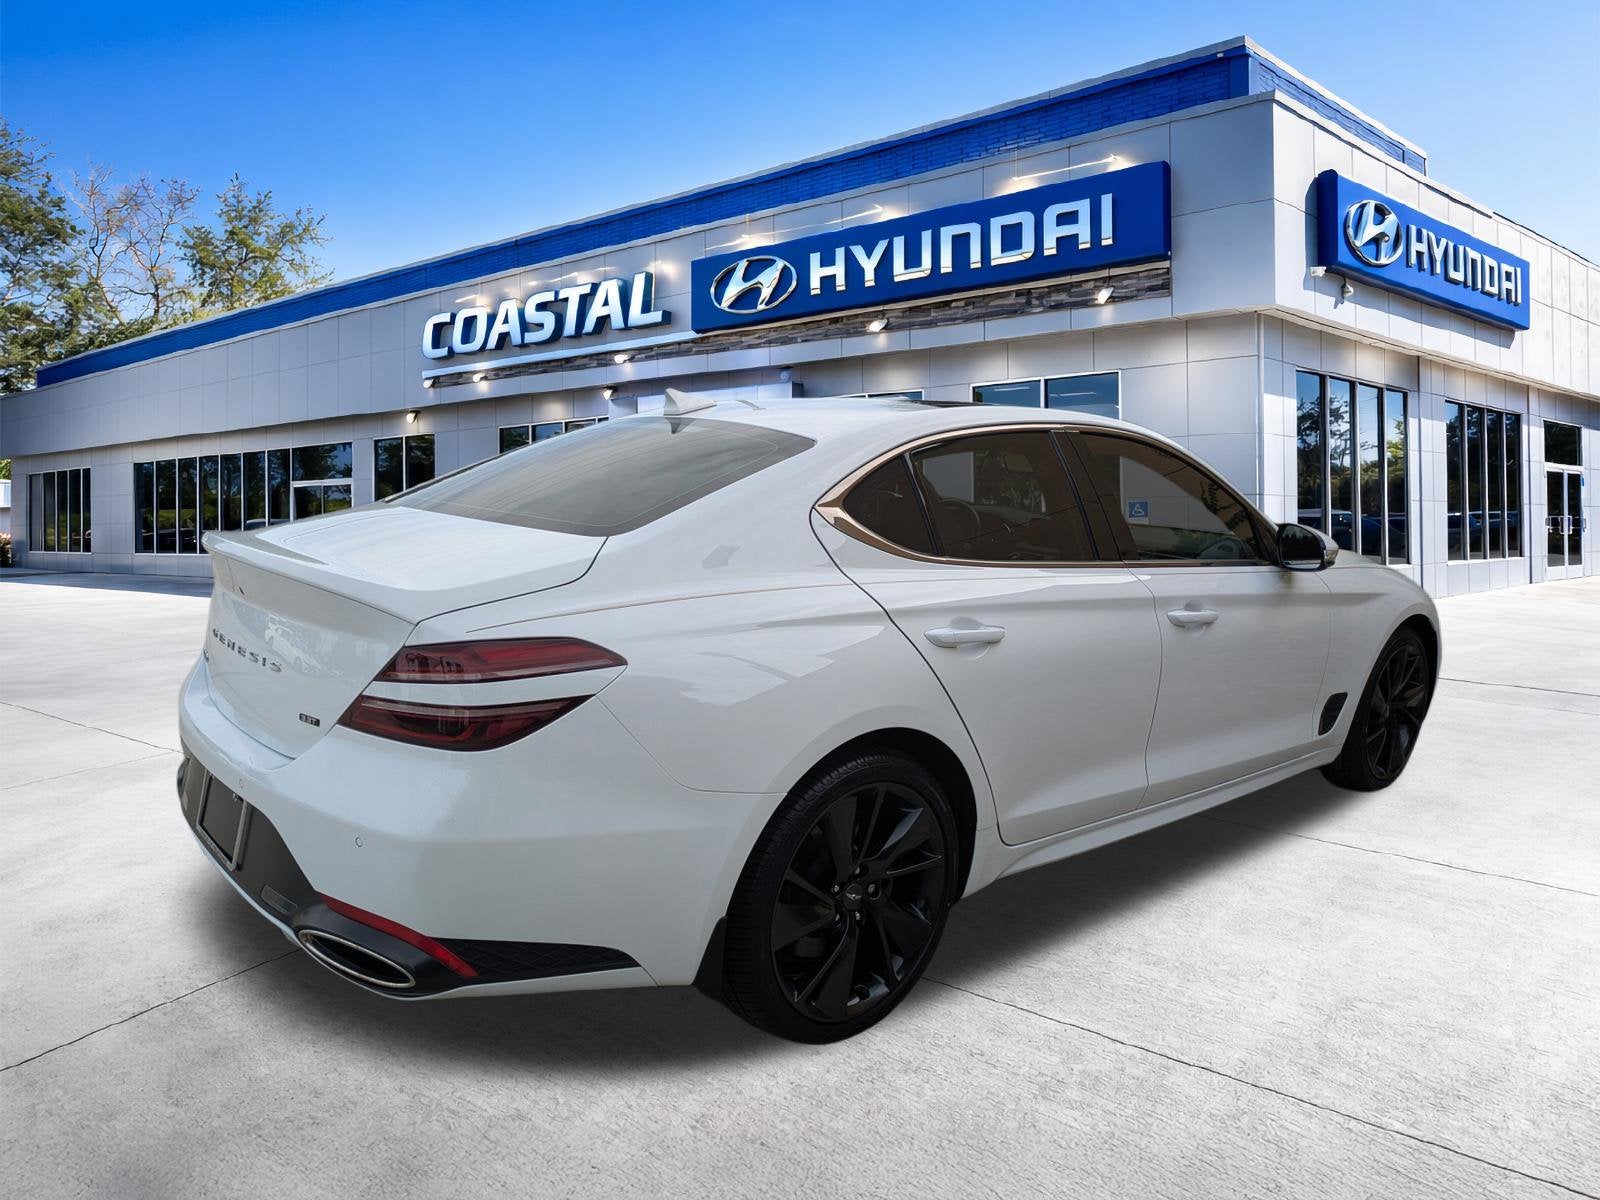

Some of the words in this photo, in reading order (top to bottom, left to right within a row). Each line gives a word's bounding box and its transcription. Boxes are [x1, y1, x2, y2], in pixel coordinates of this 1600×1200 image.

[809, 193, 1114, 296] HYUNDAI
[1408, 225, 1522, 305] HYUNDAI
[422, 271, 668, 360] COASTAL
[212, 628, 282, 673] GENESIS
